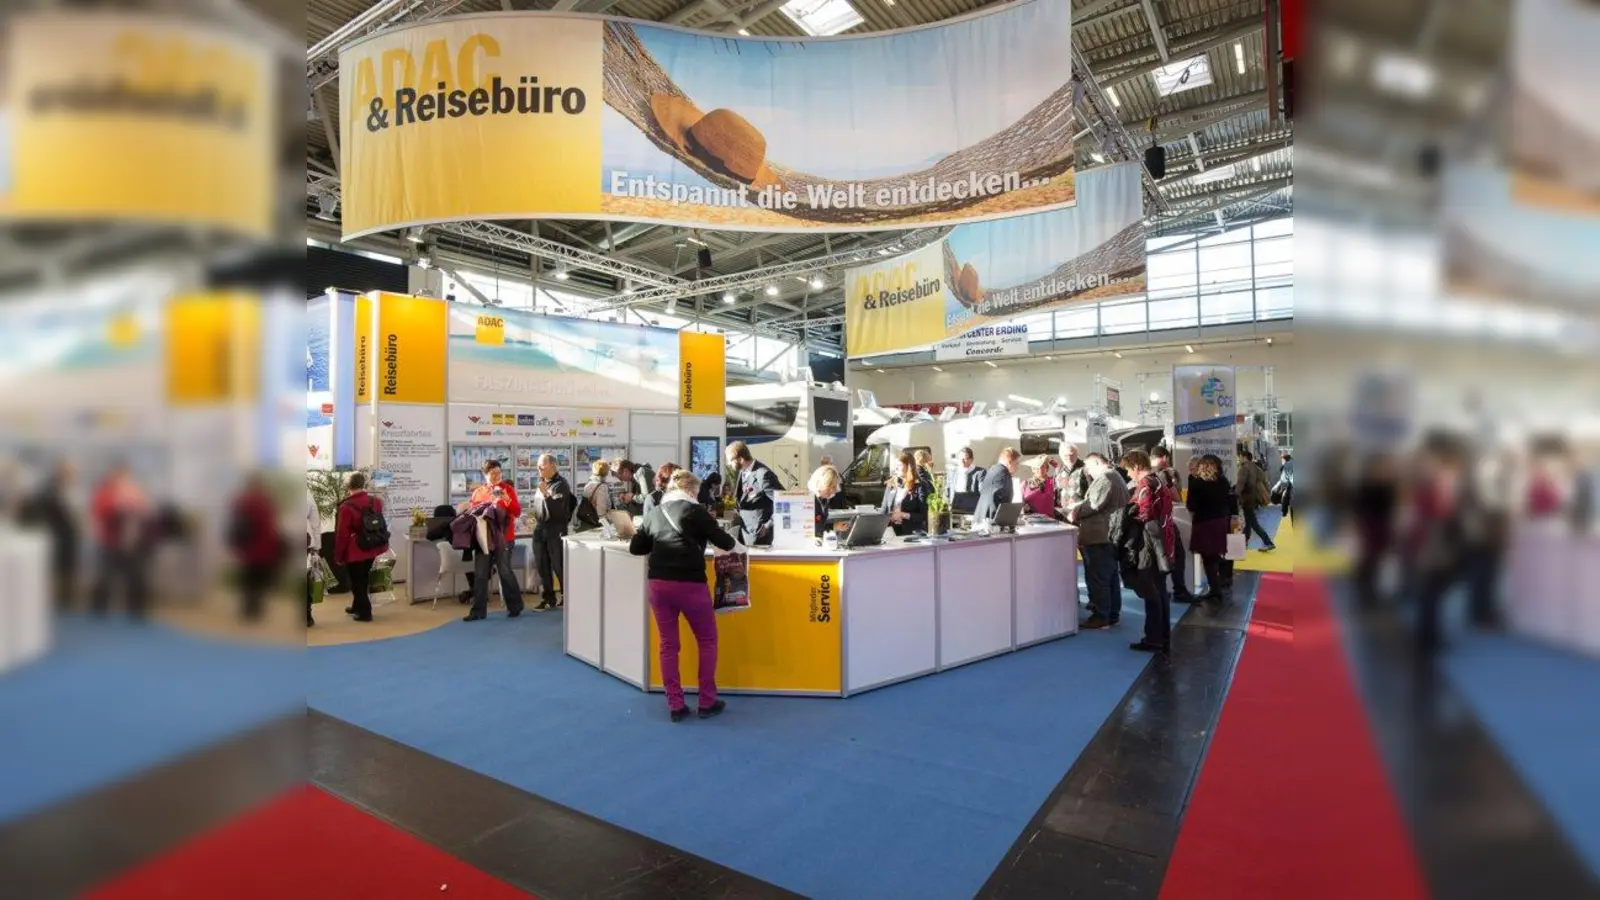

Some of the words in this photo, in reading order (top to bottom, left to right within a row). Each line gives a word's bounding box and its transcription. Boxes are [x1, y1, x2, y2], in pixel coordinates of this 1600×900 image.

[352, 33, 501, 119] ADAC
[366, 95, 389, 133] &
[395, 75, 587, 125] Reisebüro
[610, 170, 750, 208] Entspannt
[757, 183, 798, 210] die
[806, 184, 866, 210] Welt
[864, 294, 878, 311] &
[879, 277, 941, 308] Reisebüro
[977, 296, 991, 314] die
[992, 288, 1019, 311] Welt
[477, 315, 504, 328] ADAC
[966, 327, 994, 340] CENTER
[995, 324, 1028, 336] ERDING
[358, 335, 367, 397] Reisebüro
[384, 333, 398, 396] Reisebüro
[965, 346, 1004, 356] Concorde
[683, 361, 693, 410] Reisebüro
[817, 574, 830, 623] Service
